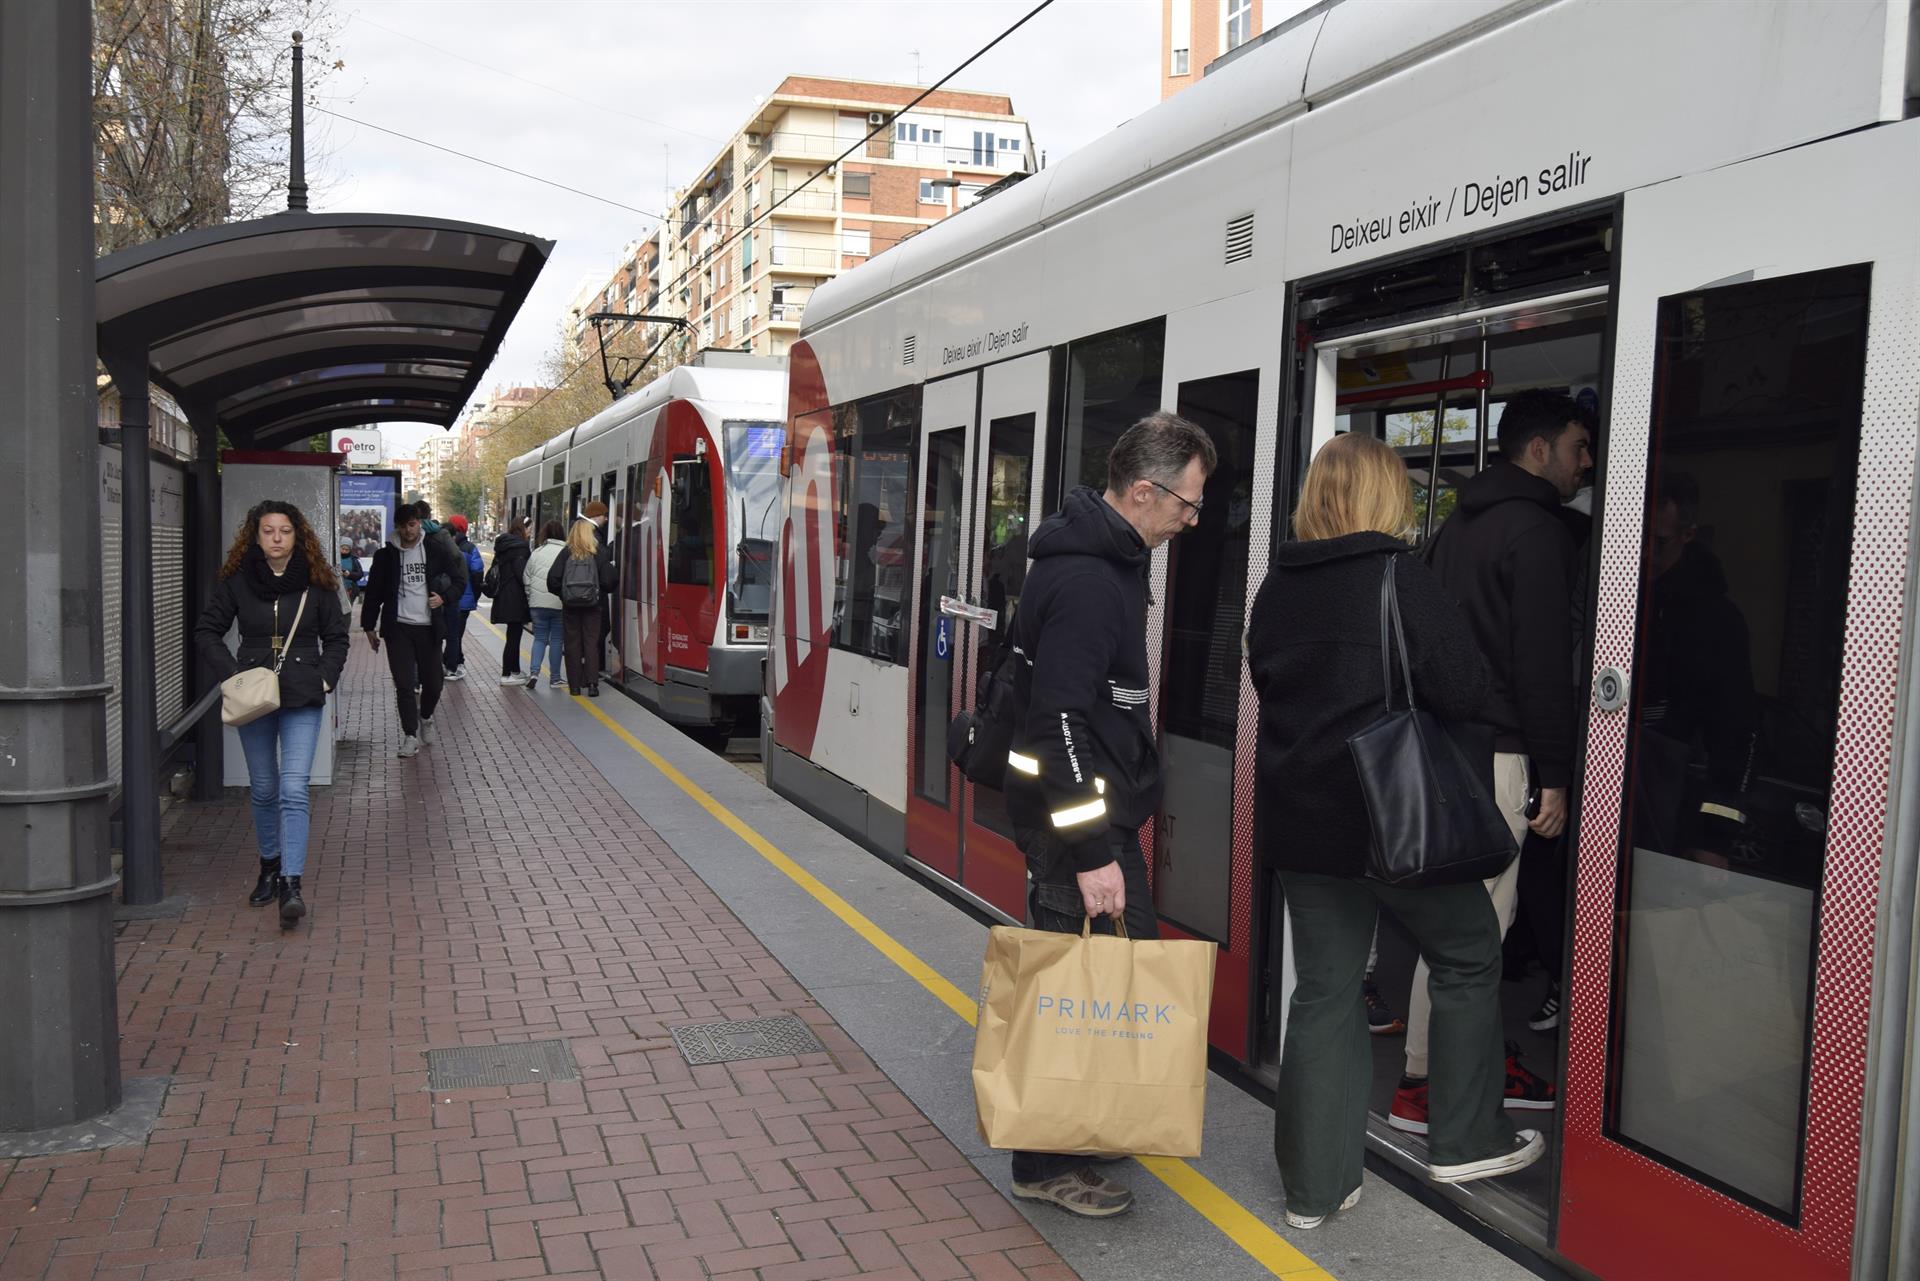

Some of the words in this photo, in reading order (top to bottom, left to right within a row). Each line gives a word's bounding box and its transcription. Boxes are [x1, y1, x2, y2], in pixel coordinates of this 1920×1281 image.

[1330, 215, 1392, 254] Deixeu
[1399, 195, 1441, 234] eixir
[1446, 186, 1457, 223] /
[1463, 174, 1529, 218] Dejen
[1537, 150, 1592, 196] salir
[943, 345, 966, 365] Deixeu
[967, 336, 982, 358] eixir
[988, 329, 1010, 353] Dejen
[1011, 321, 1029, 344] salir
[342, 441, 376, 452] metro
[407, 575, 424, 583] 1991
[1038, 996, 1172, 1025] PRIMARK
[1055, 1026, 1081, 1036] LOVE
[1087, 1028, 1107, 1037] THE
[1112, 1030, 1154, 1041] FEELING
